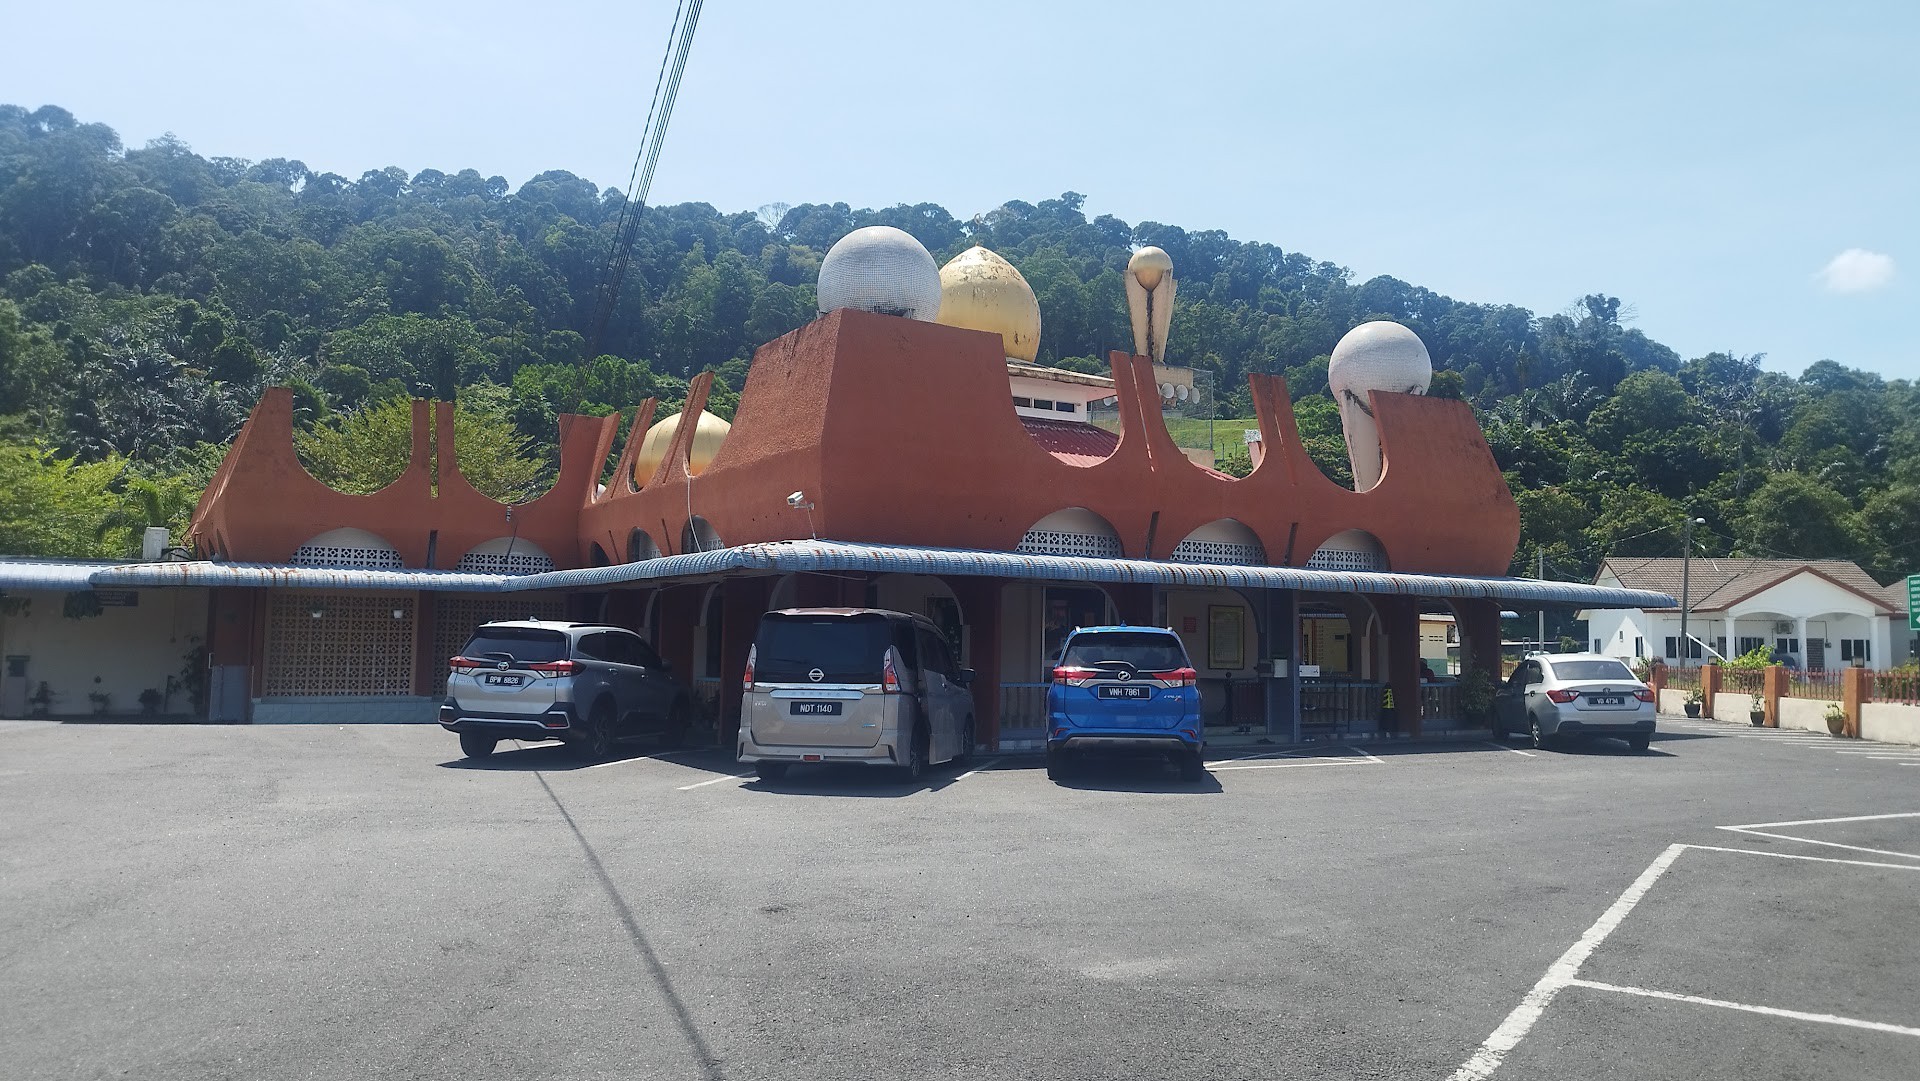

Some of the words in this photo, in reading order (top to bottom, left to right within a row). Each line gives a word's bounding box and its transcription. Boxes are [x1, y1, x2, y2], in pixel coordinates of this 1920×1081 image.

[1109, 688, 1123, 696] VNH
[1124, 688, 1140, 696] 7861
[799, 704, 816, 713] NDT
[816, 704, 832, 713] 1140
